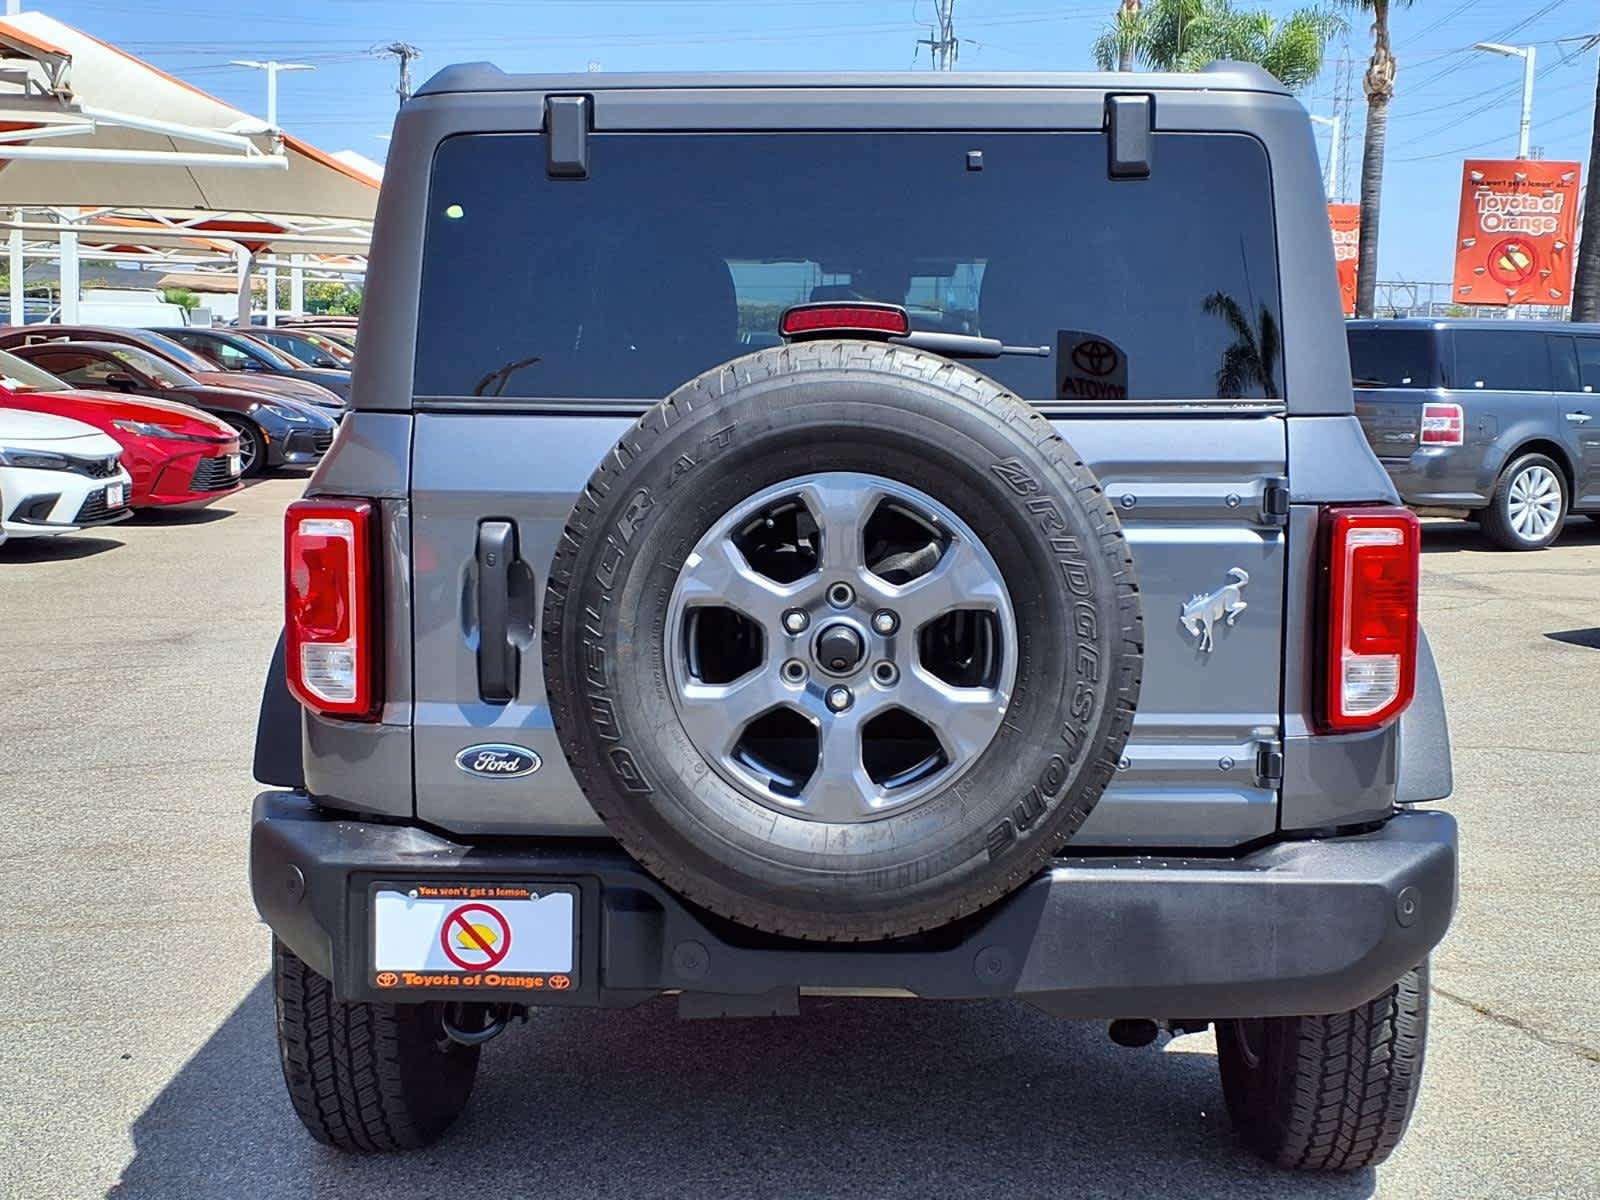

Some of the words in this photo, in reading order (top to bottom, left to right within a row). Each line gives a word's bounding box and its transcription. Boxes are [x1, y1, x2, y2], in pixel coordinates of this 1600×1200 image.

[1476, 192, 1539, 212] Toyota
[1542, 194, 1563, 212] of
[1482, 213, 1556, 234] Orange
[986, 455, 1100, 862] BRIDGESTONE
[473, 751, 520, 771] Ford
[419, 887, 438, 897] You
[440, 887, 468, 897] won't
[470, 888, 486, 898] get
[488, 888, 494, 896] a
[496, 888, 529, 897] lemon.
[402, 972, 459, 987] Toyota
[462, 974, 481, 986] of
[484, 974, 544, 988] Orange
